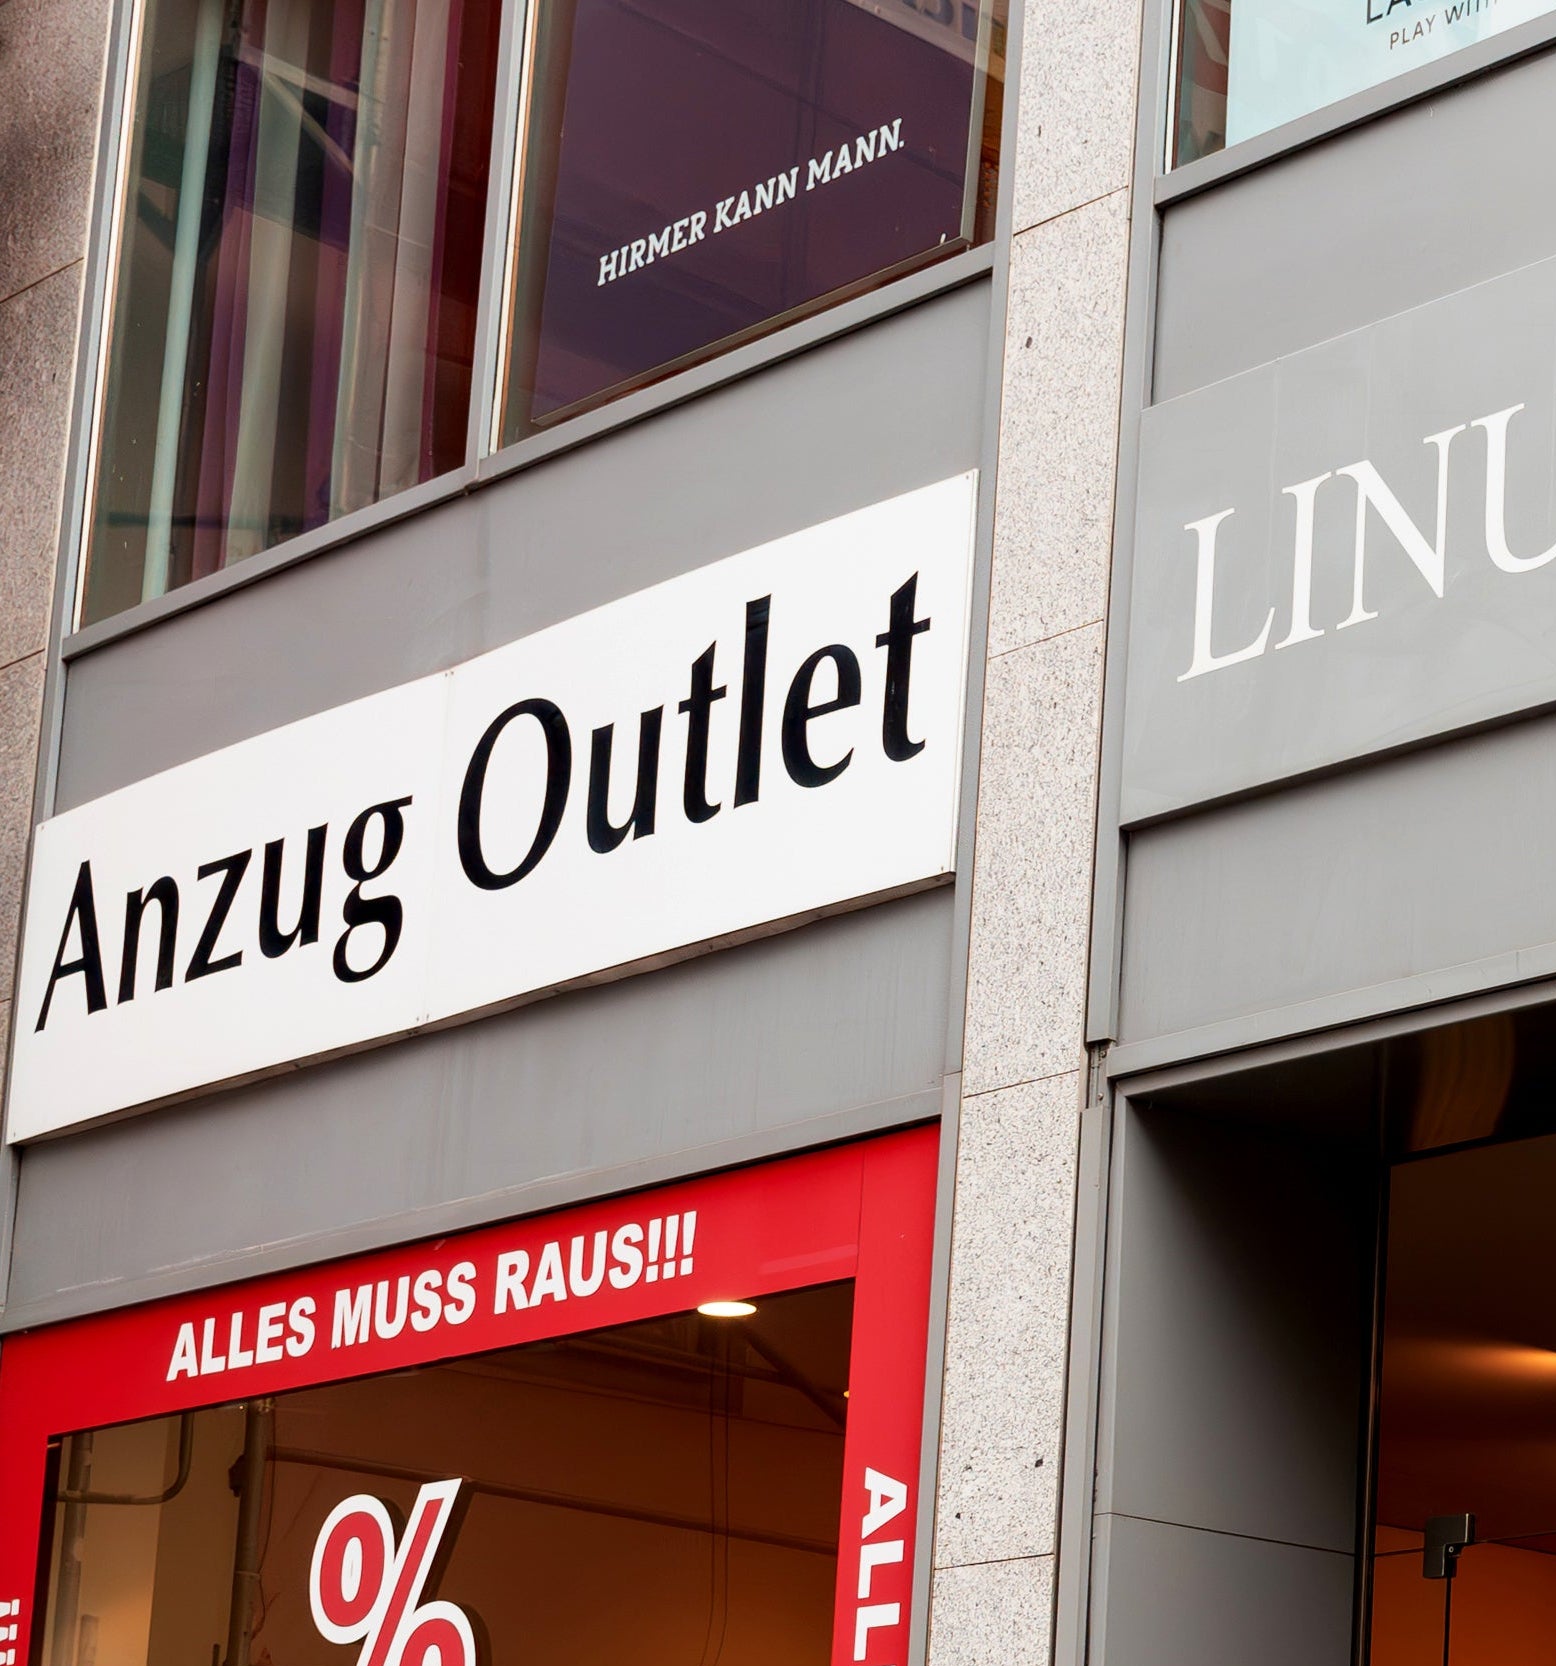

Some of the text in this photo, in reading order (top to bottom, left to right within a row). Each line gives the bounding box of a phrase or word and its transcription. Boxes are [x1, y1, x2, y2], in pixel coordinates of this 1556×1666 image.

[1390, 14, 1436, 50] PLAY
[598, 118, 905, 286] HIRMER KANN MANN.
[34, 571, 931, 1034] Anzug Outlet
[167, 1210, 697, 1382] ALLES MUSS RAUS!!!
